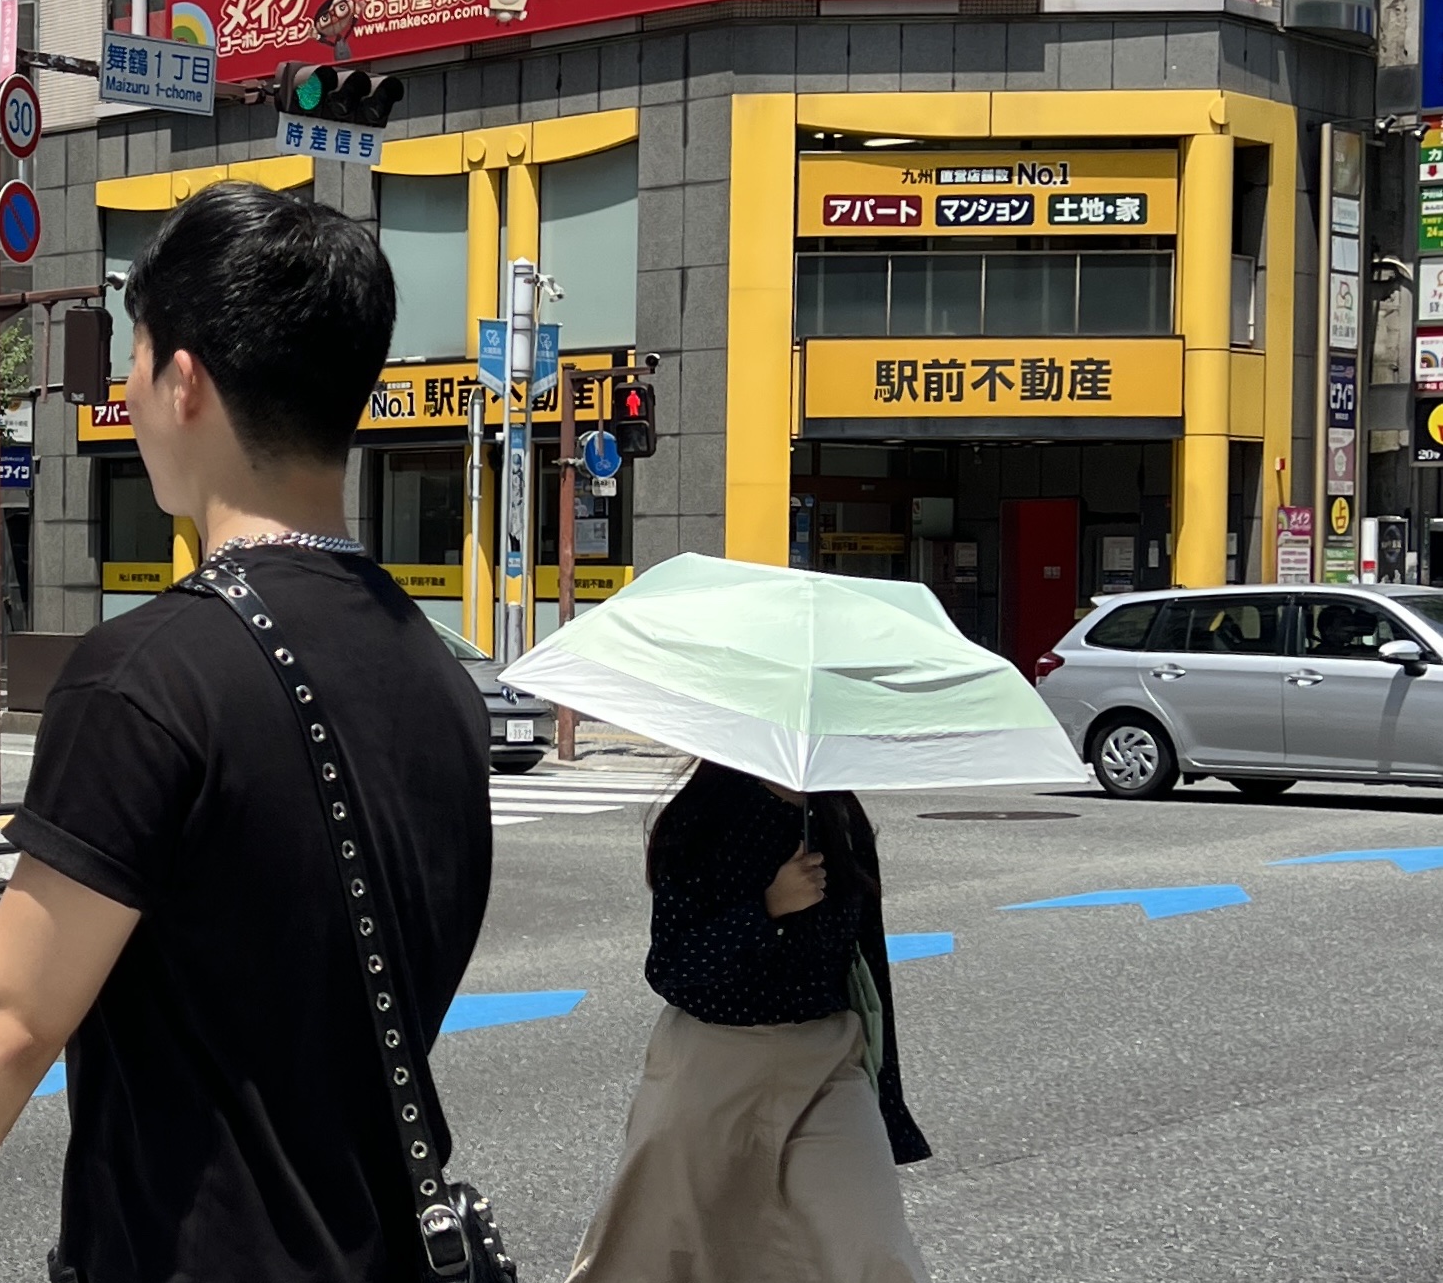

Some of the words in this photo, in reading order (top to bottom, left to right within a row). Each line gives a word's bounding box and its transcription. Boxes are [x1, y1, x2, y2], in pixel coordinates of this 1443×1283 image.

[353, 3, 484, 38] www.makecorp.com
[218, 21, 314, 54] コーポレーション
[105, 75, 150, 96] Maizuru
[156, 82, 203, 103] 1-chome
[9, 98, 33, 137] 30
[285, 122, 375, 158] 時差信号
[901, 169, 933, 185] 九州
[1016, 162, 1070, 186] No.1
[829, 198, 918, 224] アパート
[940, 198, 1030, 223] マンション
[1053, 196, 1141, 223] 土地・家
[873, 357, 1113, 403] 駅前不動産
[94, 404, 131, 424] アパー
[371, 390, 416, 419] No.1
